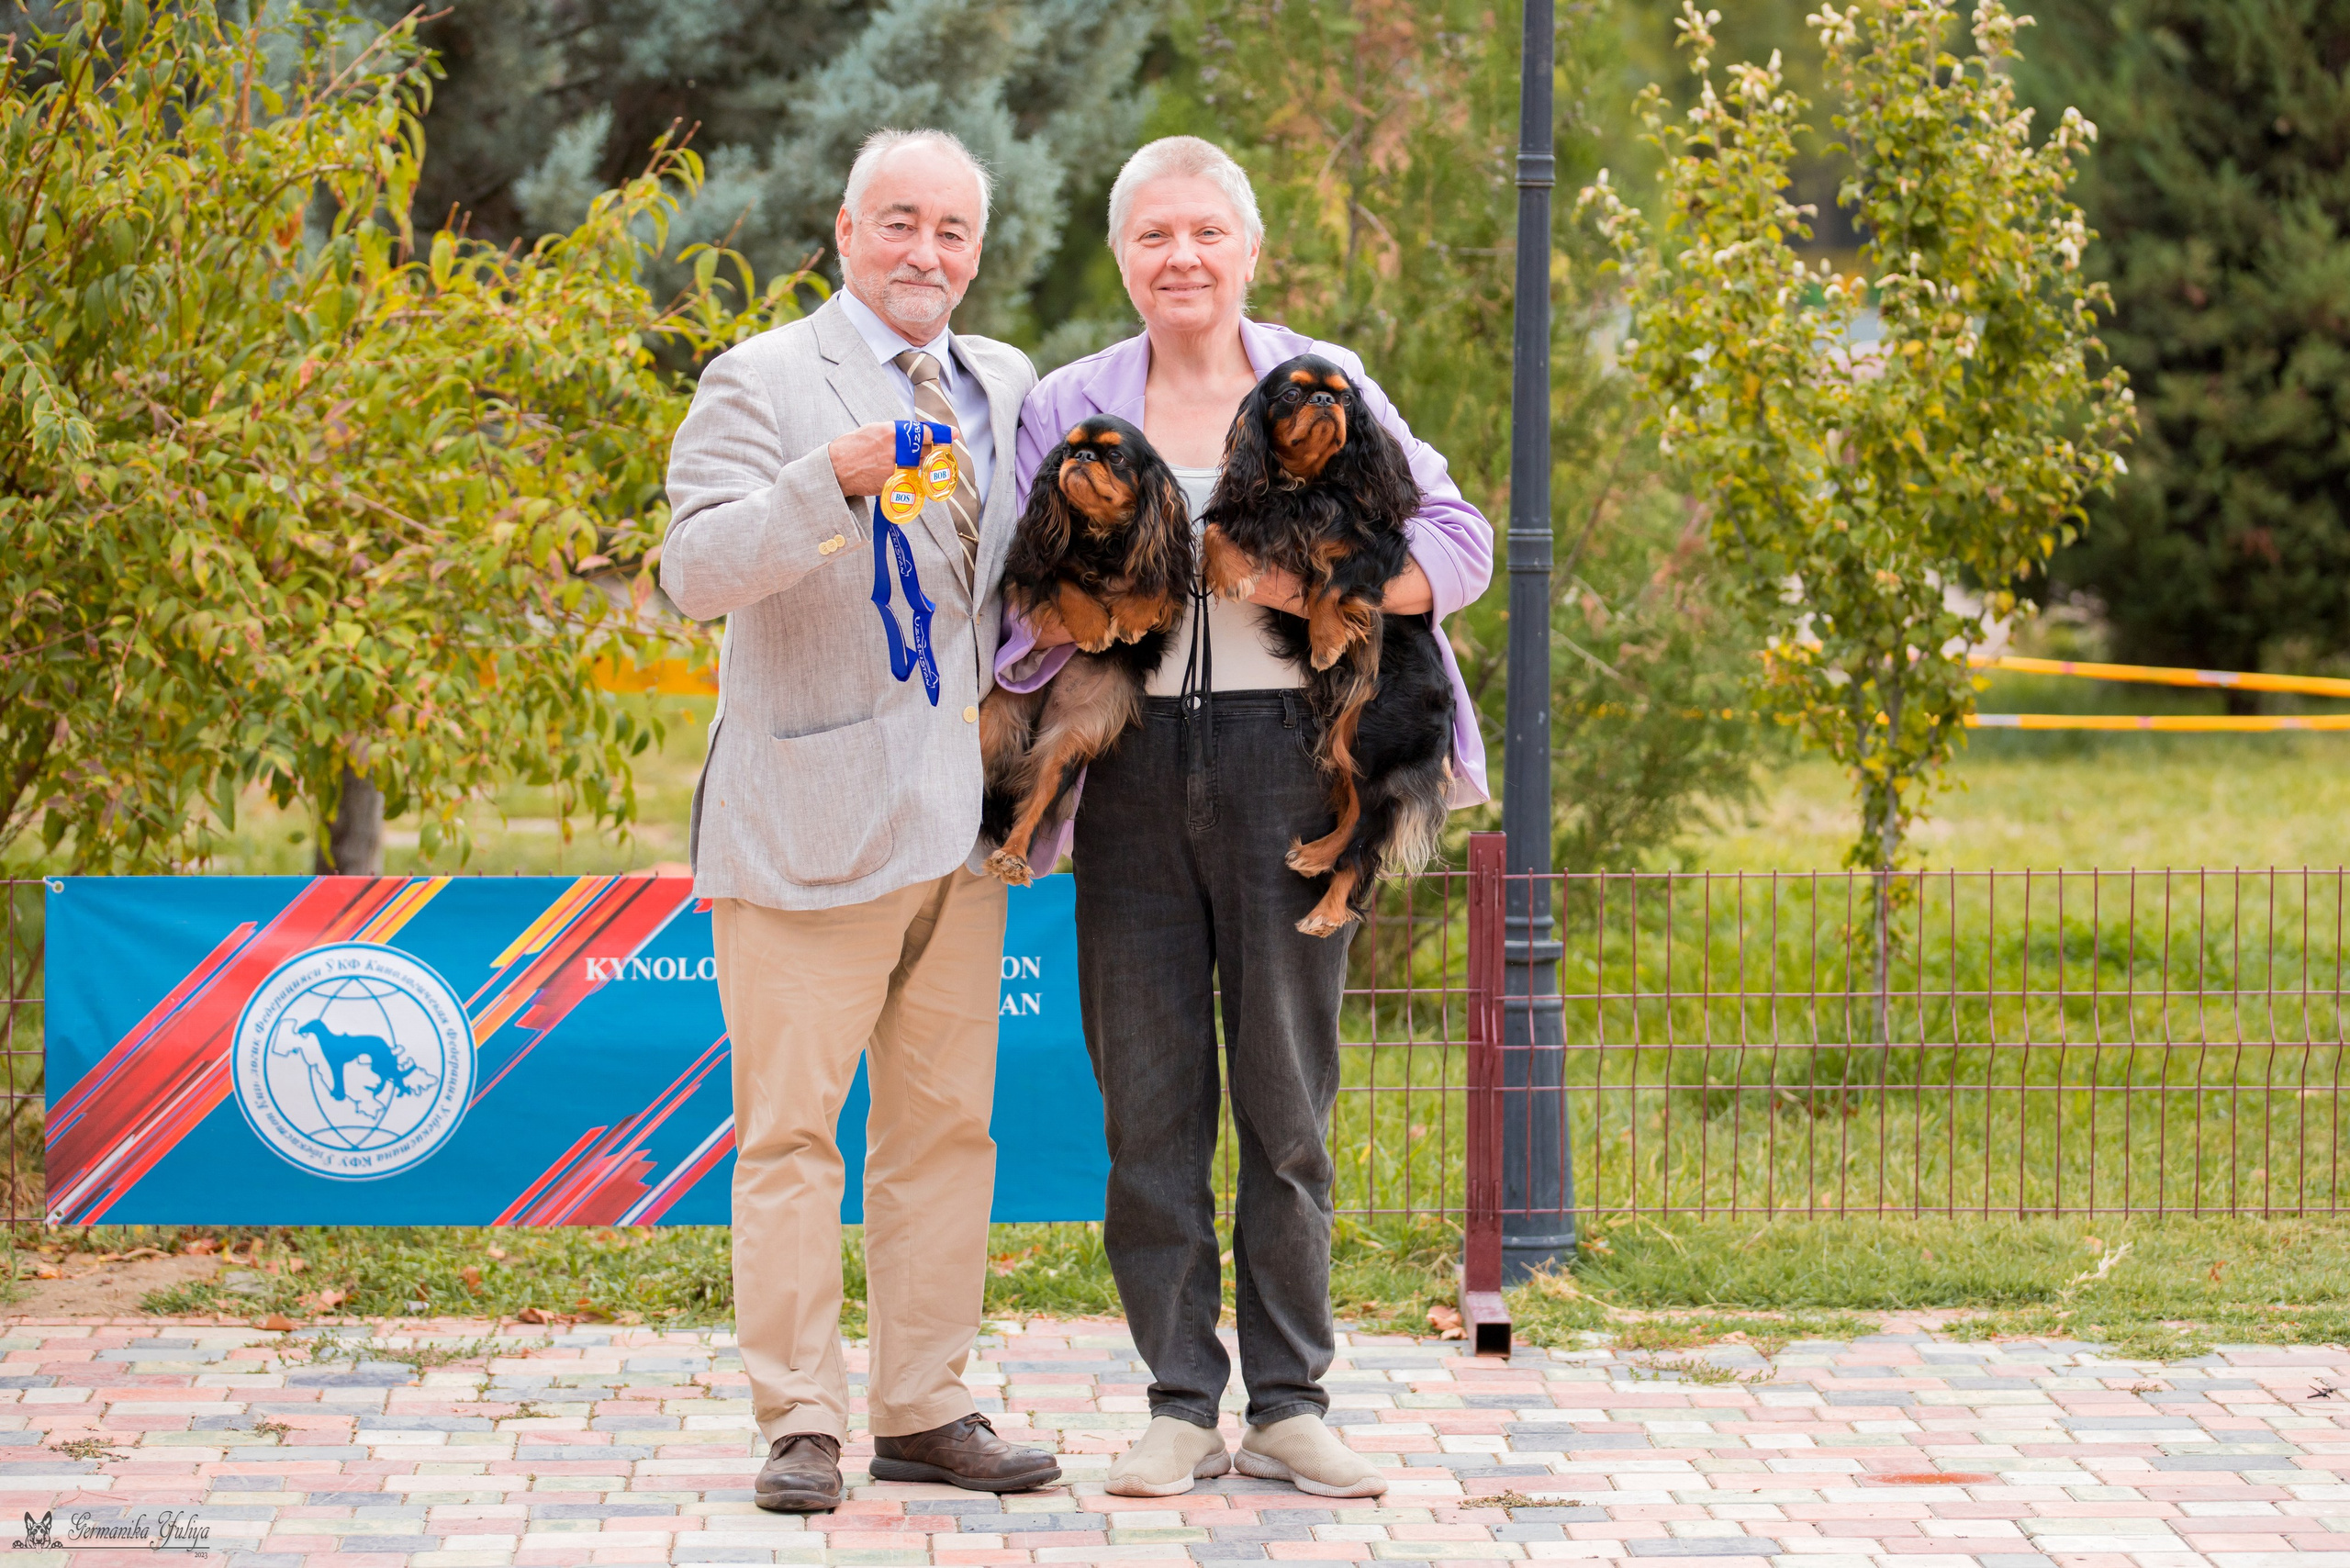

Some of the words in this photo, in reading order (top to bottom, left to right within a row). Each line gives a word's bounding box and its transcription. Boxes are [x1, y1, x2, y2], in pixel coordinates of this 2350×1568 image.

[933, 470, 947, 481] BOB
[895, 493, 911, 502] BOS
[914, 616, 932, 687] UZBEKISTAN
[999, 992, 1043, 1016] AN
